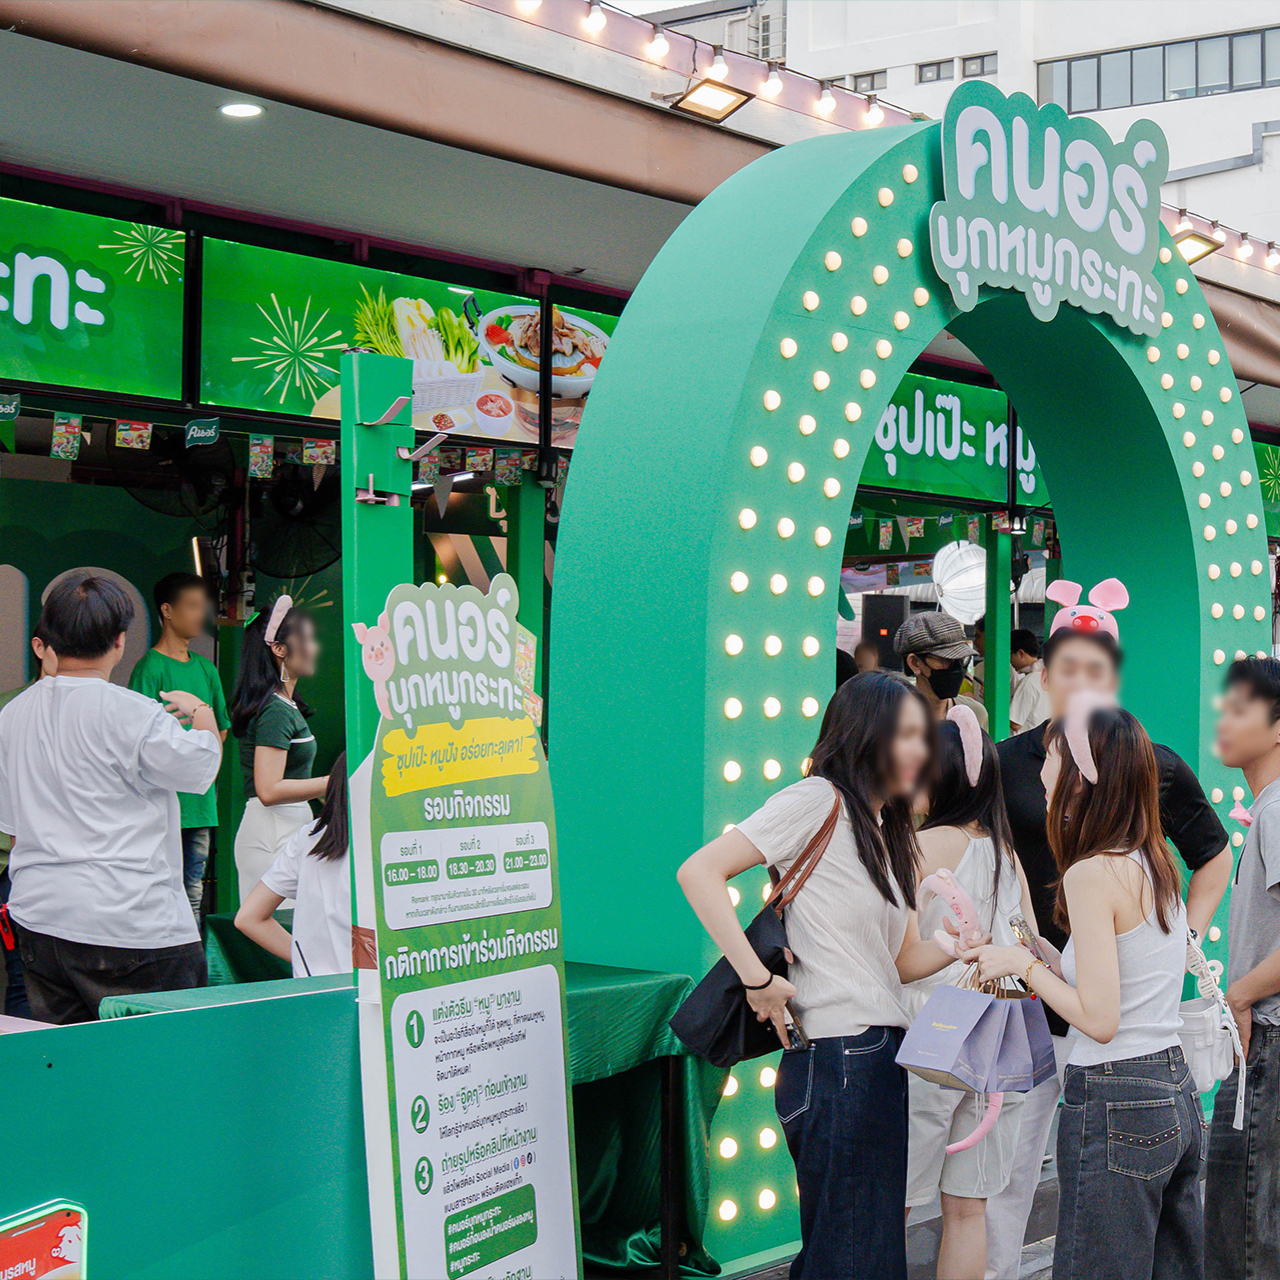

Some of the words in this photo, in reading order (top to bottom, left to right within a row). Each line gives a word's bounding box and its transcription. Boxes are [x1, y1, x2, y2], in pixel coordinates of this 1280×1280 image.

[953, 104, 1157, 257] คนอร์
[937, 212, 1157, 329] บุกหมูกระทะ
[187, 420, 218, 439] คนอร์
[985, 420, 1037, 495] หมู
[393, 587, 513, 669] คนอร์
[388, 669, 524, 730] บุกหมูกระทะ
[396, 747, 428, 779] ซุปเป๊ะ
[429, 744, 460, 772] หมูปัง
[424, 789, 511, 823] รอบกิจกรรม
[400, 838, 418, 857] รอบที่
[459, 833, 475, 852] รอบที่
[475, 839, 482, 850] 2
[515, 830, 527, 847] รอบที่
[527, 836, 535, 846] 3
[387, 868, 409, 883] 16.00
[416, 865, 438, 879] 18.00
[448, 862, 469, 876] 18.30
[475, 859, 495, 873] 20.30
[505, 856, 524, 869] 21.00
[529, 853, 547, 867] 23.00
[385, 927, 559, 980] กติกาการเข้าร่วมกิจกรรม
[409, 1013, 419, 1044] 1
[414, 1098, 427, 1130] 2
[437, 1092, 455, 1113] ร้อง
[418, 1159, 430, 1191] 3
[475, 1166, 494, 1183] Social
[493, 1162, 510, 1177] Media
